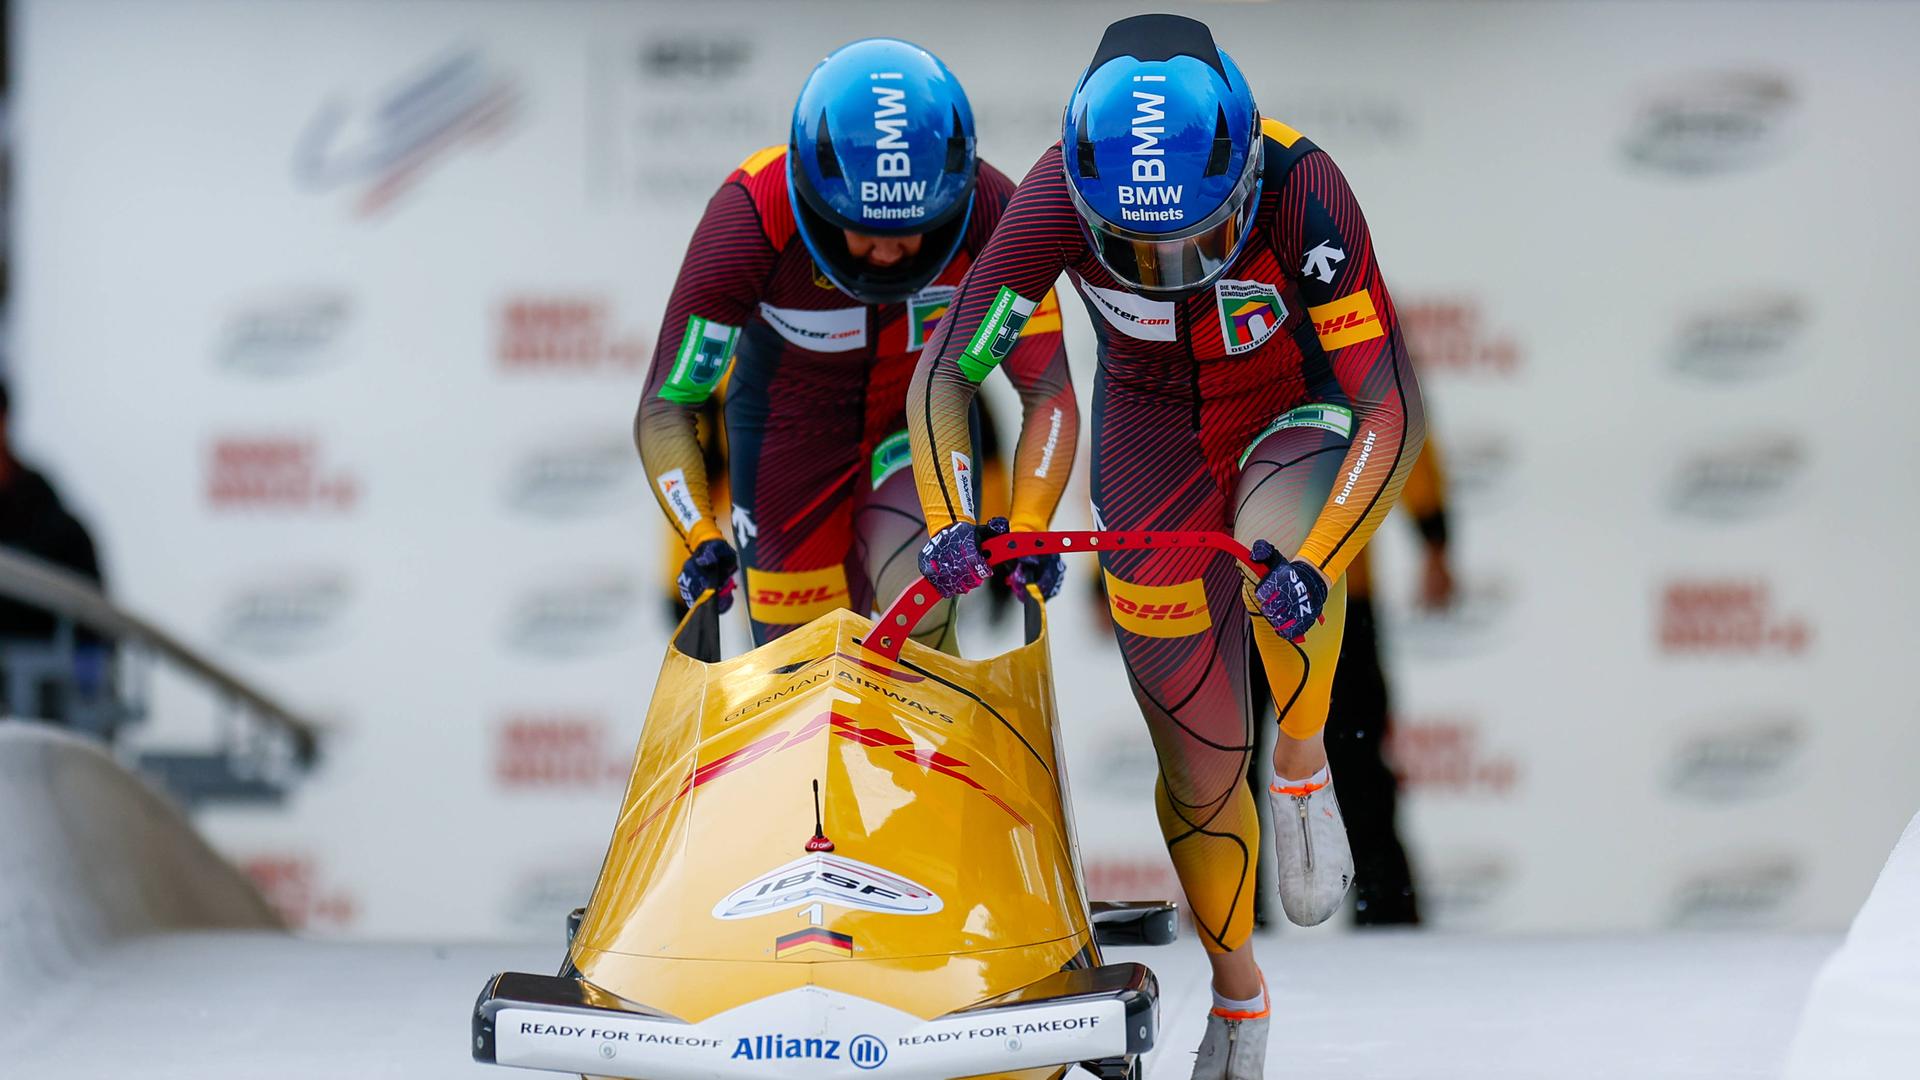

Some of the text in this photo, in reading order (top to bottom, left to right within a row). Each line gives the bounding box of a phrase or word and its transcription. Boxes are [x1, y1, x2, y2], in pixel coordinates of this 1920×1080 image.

[870, 72, 911, 178] BMW i
[1132, 91, 1166, 182] BMW
[861, 181, 927, 203] BMW
[1118, 185, 1183, 206] BMW
[862, 204, 925, 219] helmets
[1121, 207, 1184, 221] helmets
[972, 290, 1012, 355] HERRENKNECHT
[1231, 314, 1286, 353] DEUTSCHLAND
[1034, 407, 1062, 478] Bundeswehr
[1334, 431, 1377, 506] Bundeswehr
[757, 586, 832, 606] DHL
[1115, 594, 1195, 620] DHL
[1289, 569, 1313, 618] SEIZ
[725, 669, 954, 724] GERMAN AIRWAYS
[756, 870, 902, 900] IBSF
[798, 903, 824, 926] 1
[520, 1022, 724, 1049] READY FOR TAKEOFF
[899, 1016, 1101, 1047] READY FOR TAKEOFF
[731, 1034, 840, 1061] Allianz
